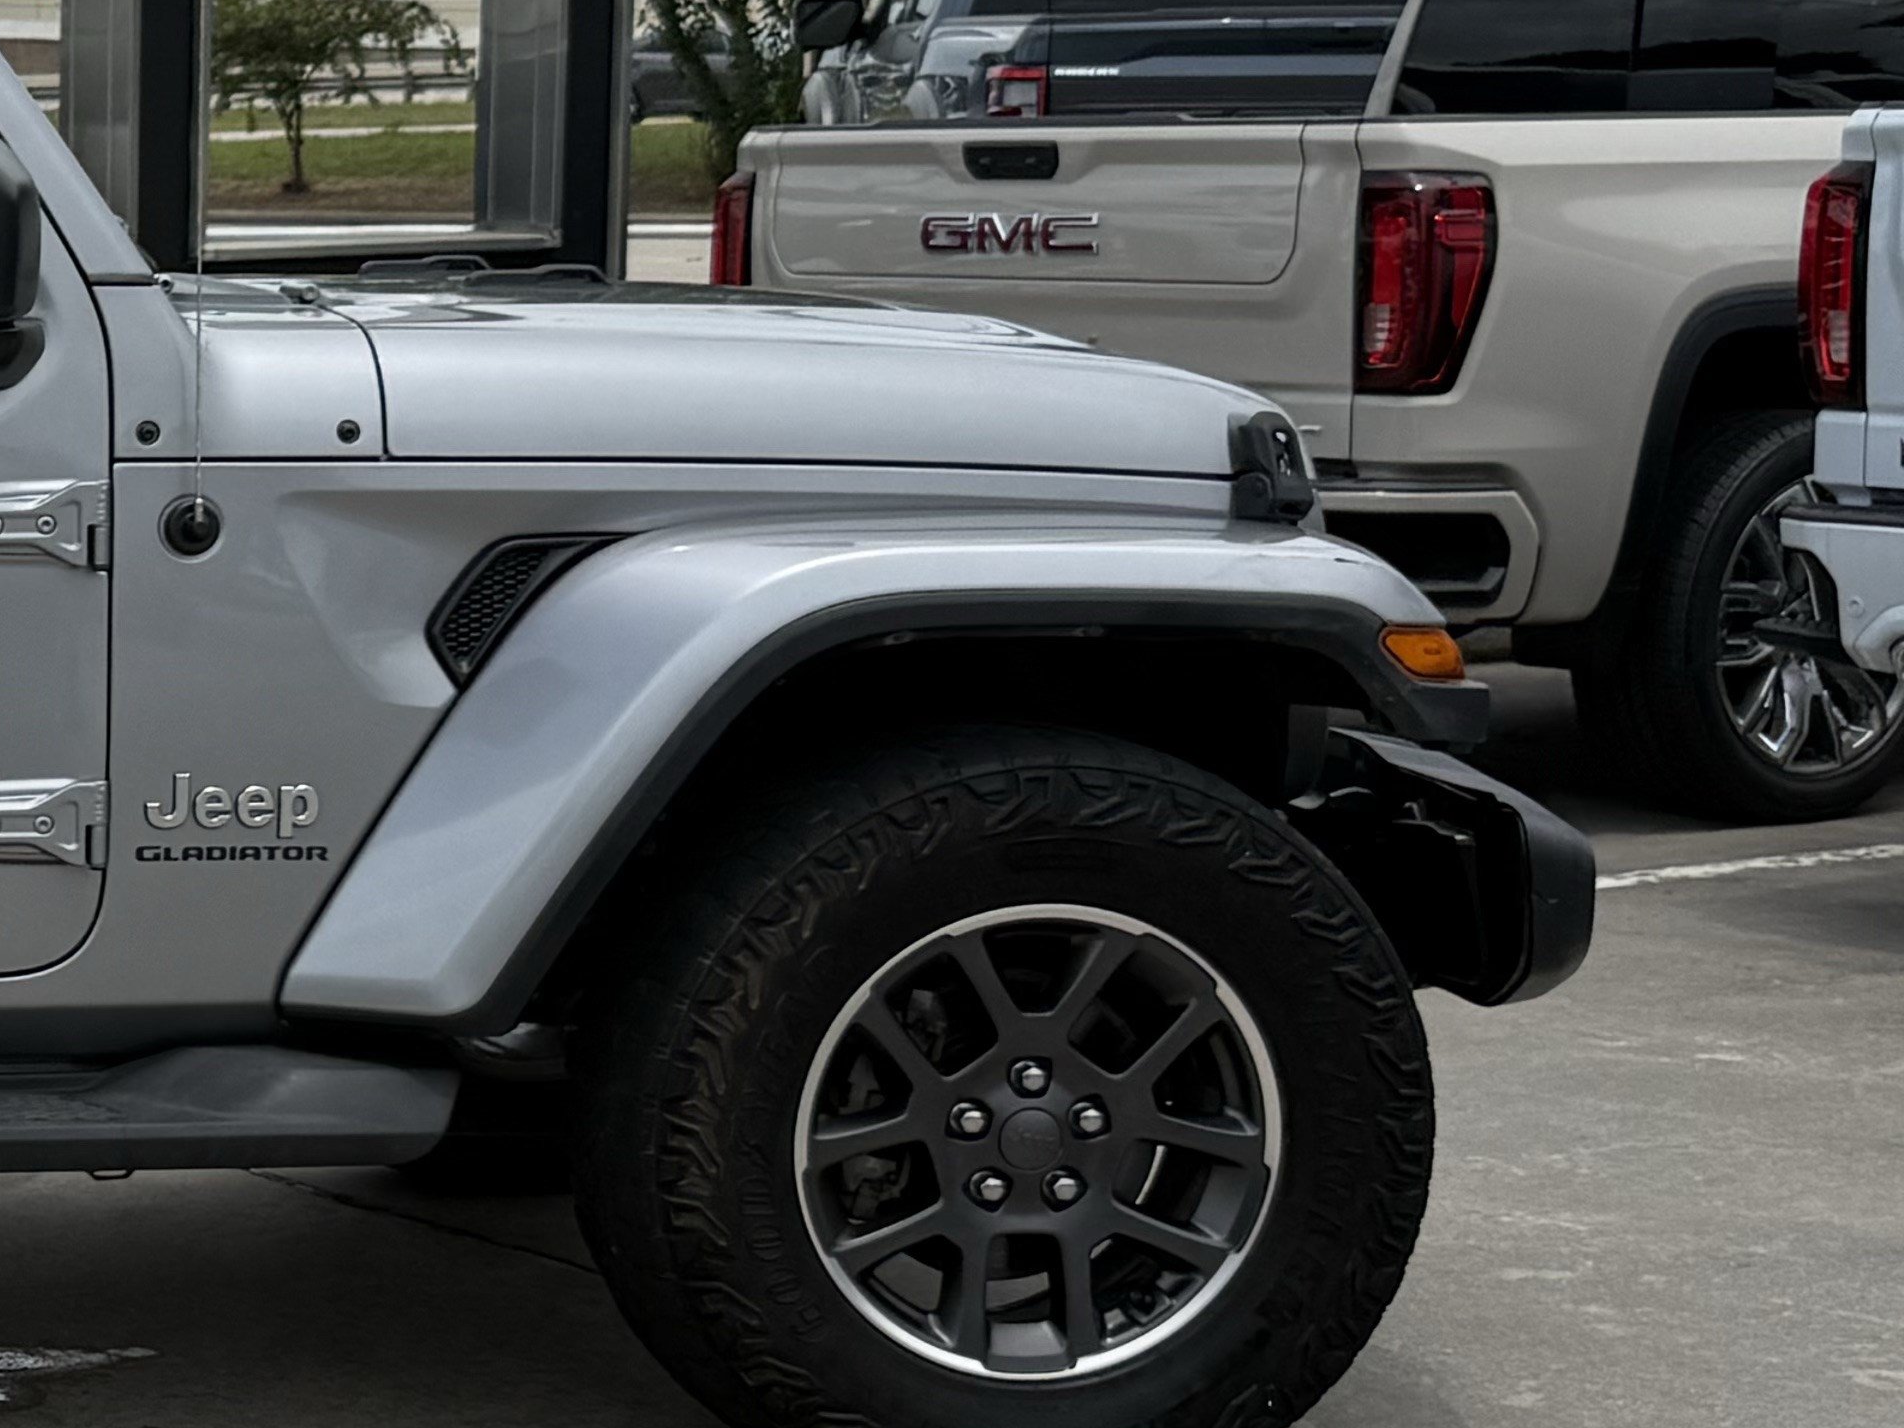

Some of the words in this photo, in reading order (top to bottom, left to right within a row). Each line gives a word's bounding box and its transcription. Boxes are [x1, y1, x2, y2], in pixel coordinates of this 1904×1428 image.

[920, 212, 1100, 256] GMC
[144, 772, 320, 840] Jeep
[135, 845, 330, 862] GLADIATOR
